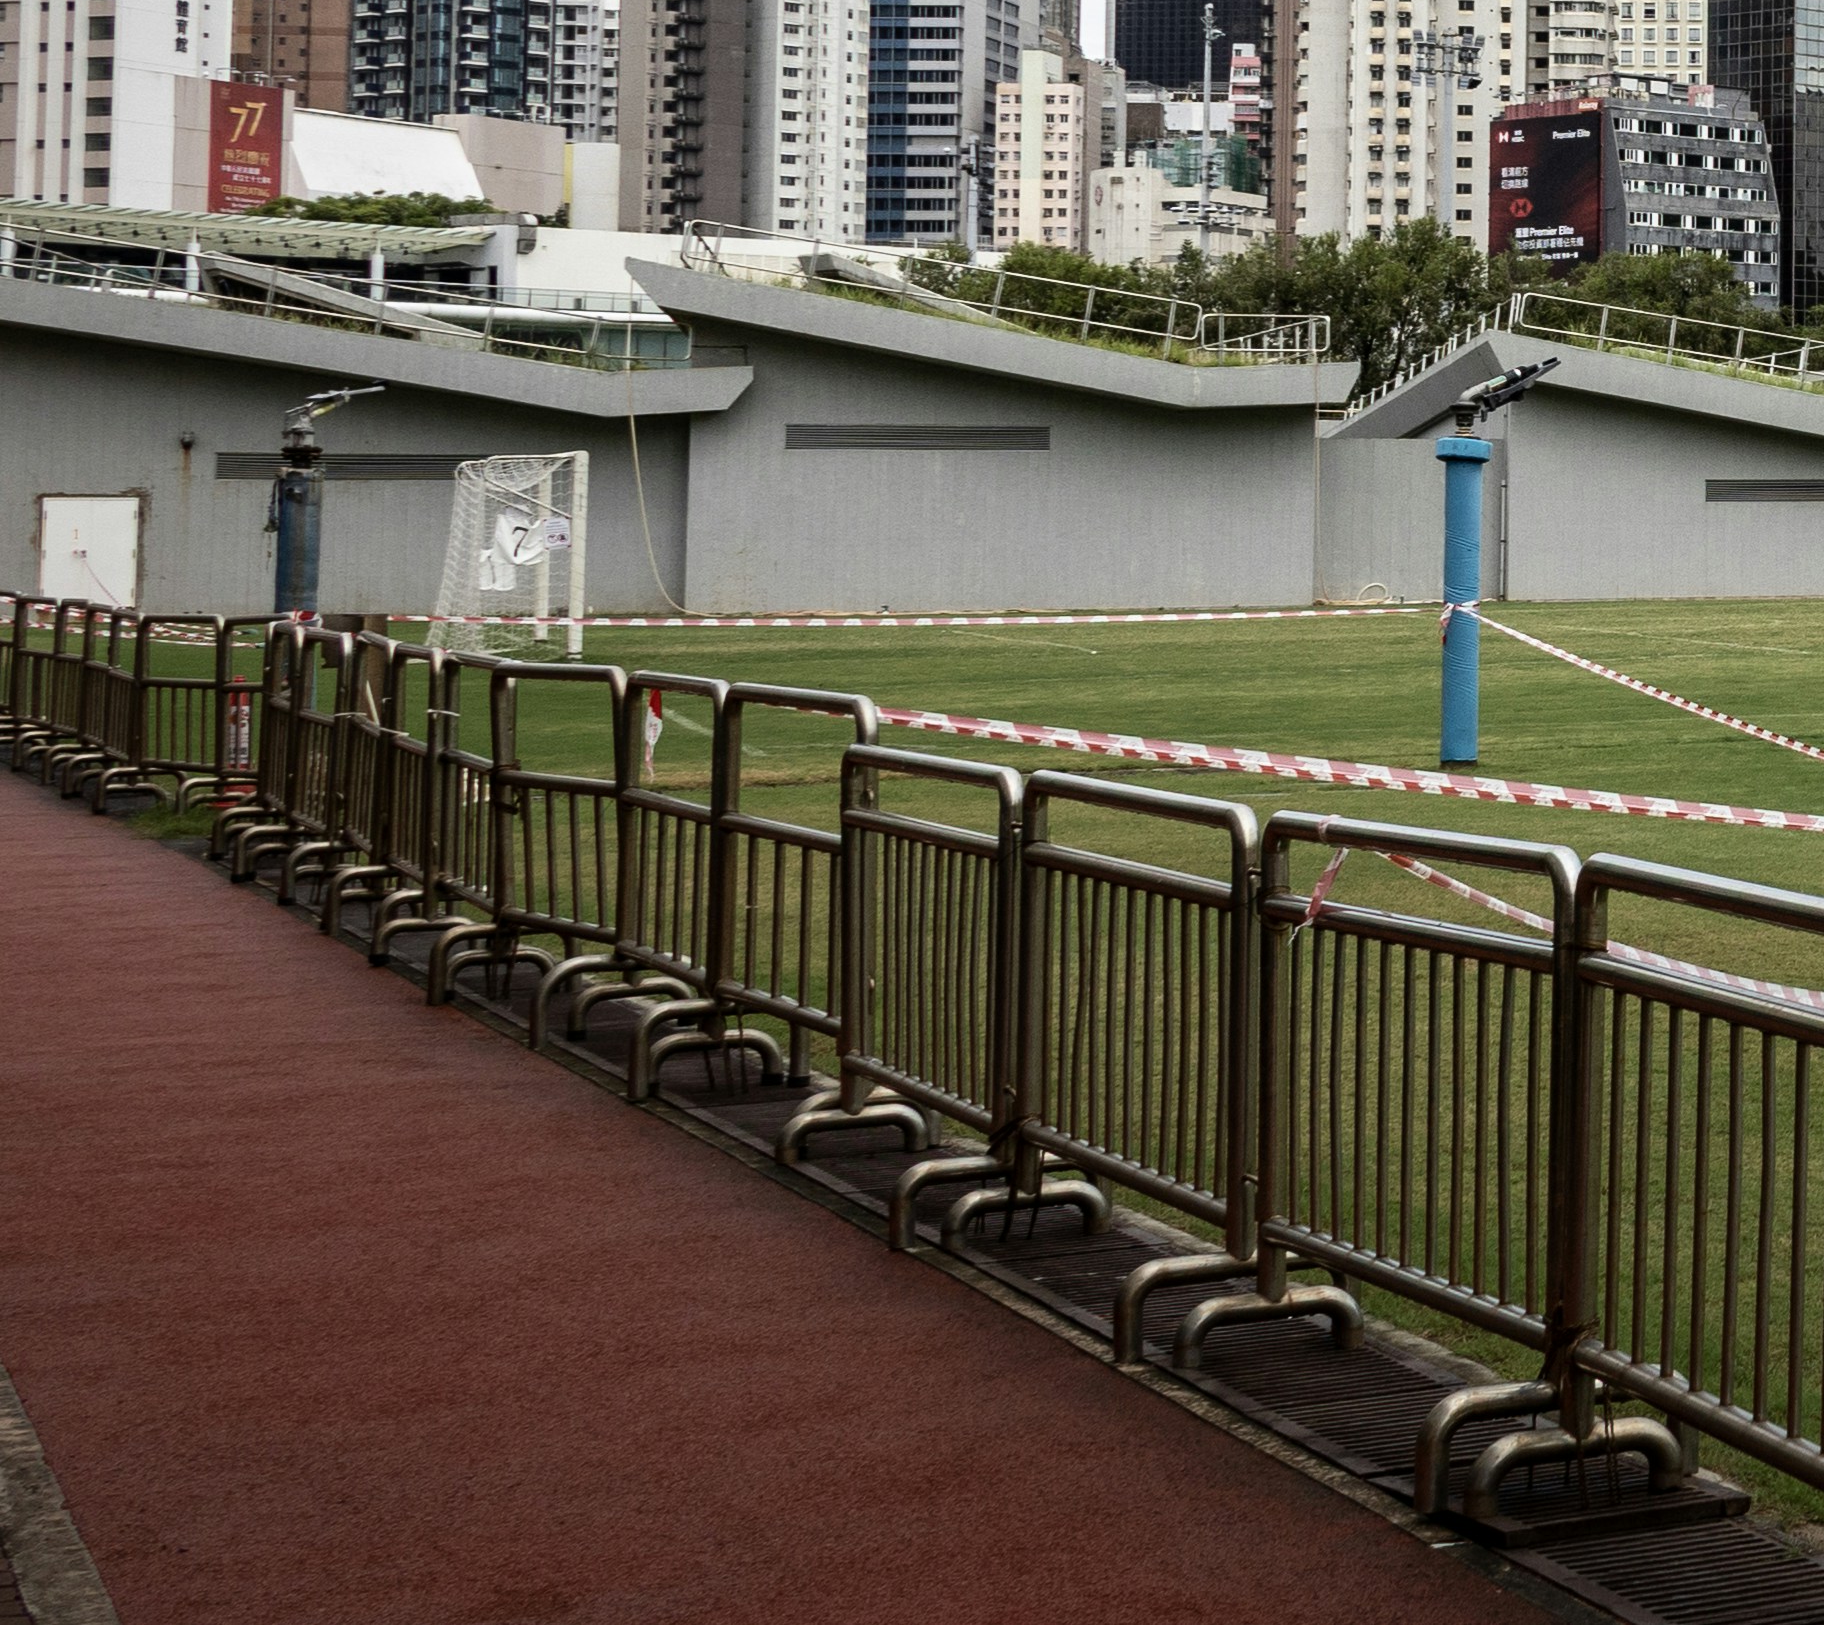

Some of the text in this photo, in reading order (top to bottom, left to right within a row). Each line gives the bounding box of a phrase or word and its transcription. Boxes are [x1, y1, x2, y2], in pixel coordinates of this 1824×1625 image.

[229, 101, 267, 142] 77
[1552, 128, 1591, 139] Premier Elite
[1559, 225, 1575, 235] Elite
[512, 526, 529, 557] 7
